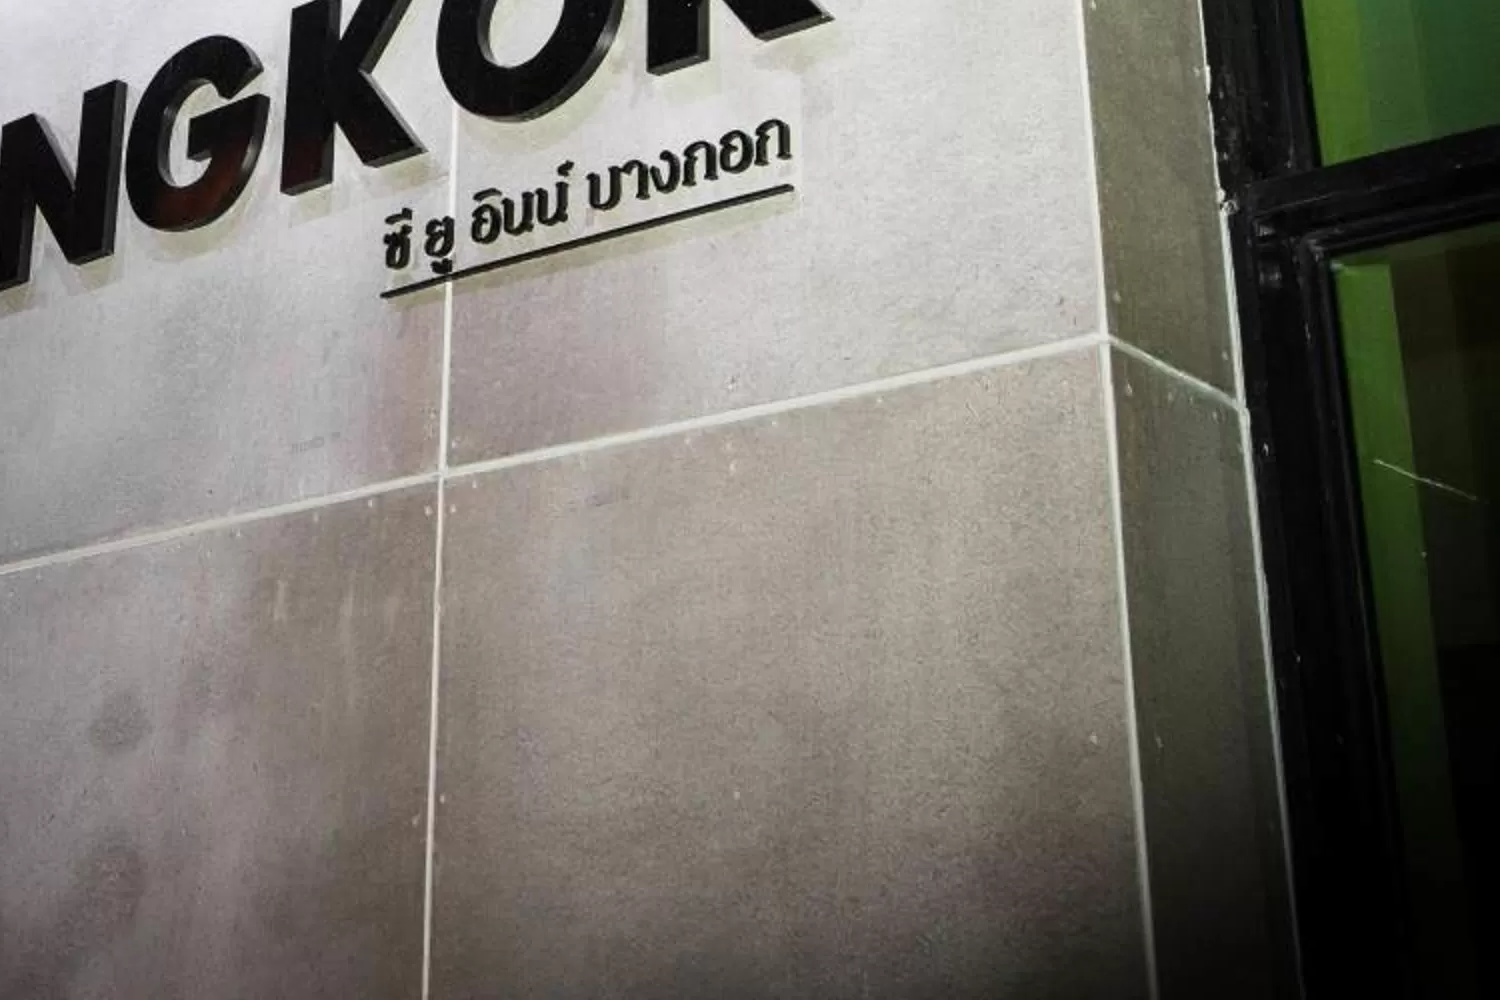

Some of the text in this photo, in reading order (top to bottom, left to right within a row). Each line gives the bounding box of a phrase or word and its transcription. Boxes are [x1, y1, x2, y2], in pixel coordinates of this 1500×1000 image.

[470, 159, 575, 245] อินน์
[586, 118, 792, 211] บางกอก
